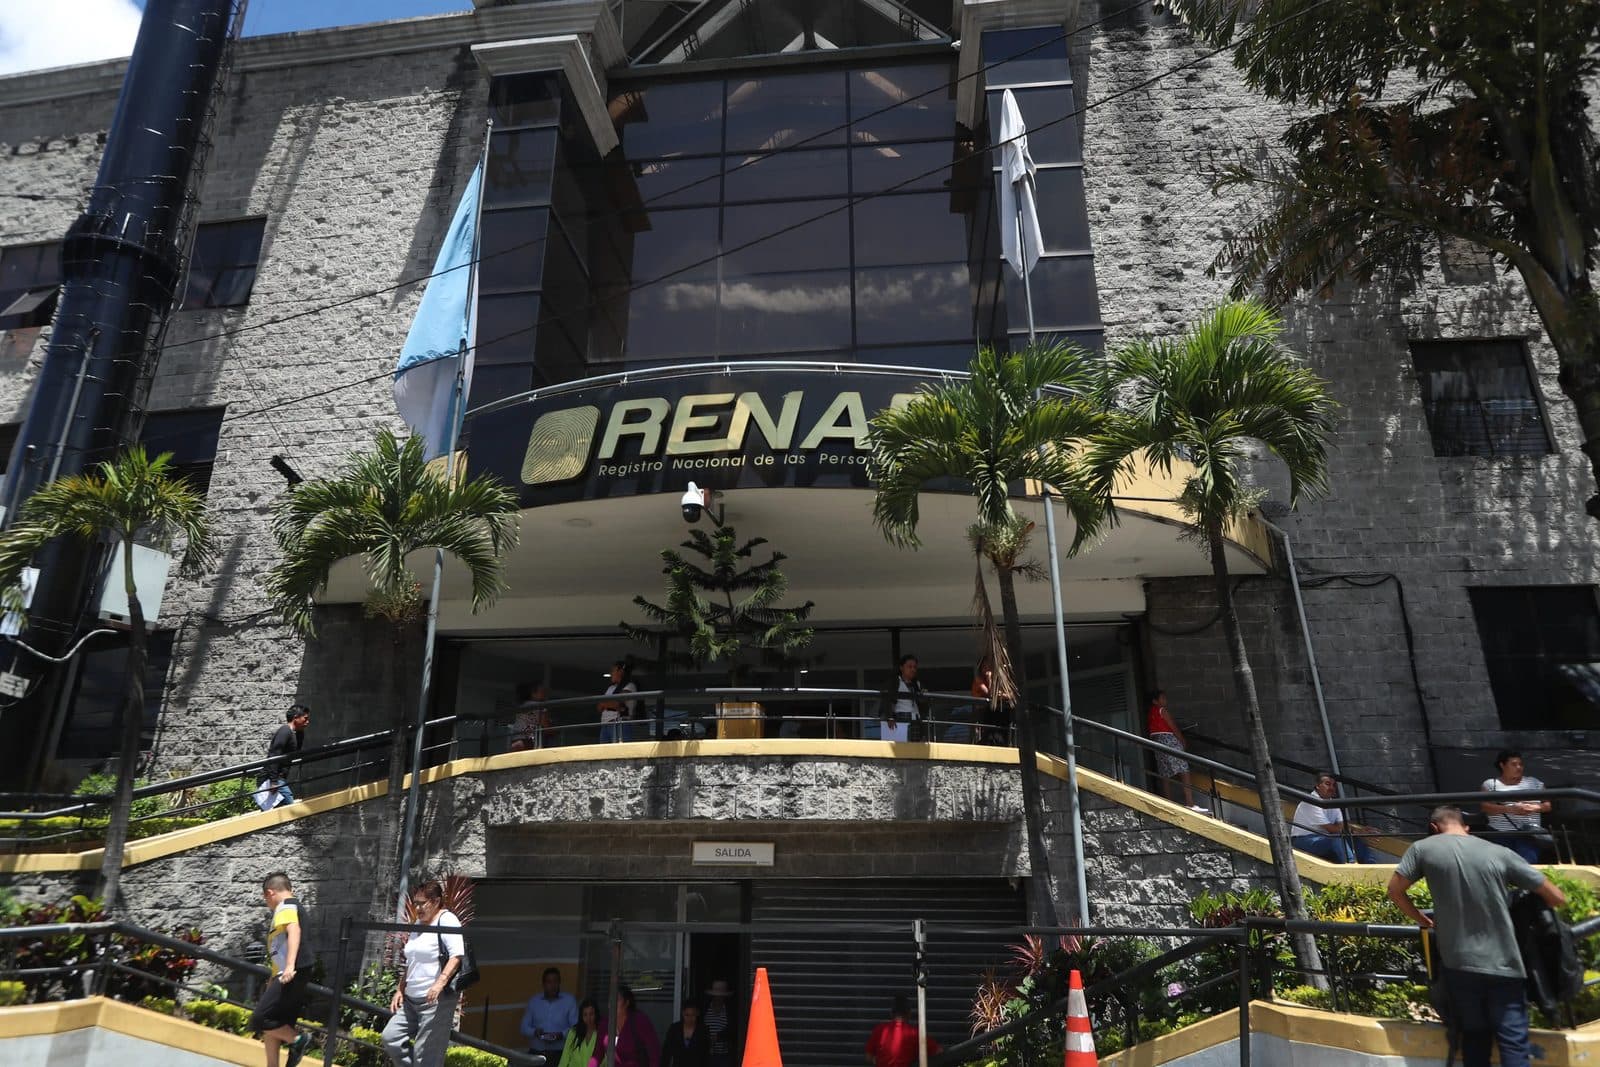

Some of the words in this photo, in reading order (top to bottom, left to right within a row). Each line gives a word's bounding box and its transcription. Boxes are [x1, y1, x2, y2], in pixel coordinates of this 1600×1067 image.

[598, 460, 663, 477] Registro
[672, 454, 746, 470] Nacional
[753, 453, 775, 466] de
[783, 453, 806, 465] las
[818, 452, 884, 466] Person
[715, 848, 752, 857] SALIDA
